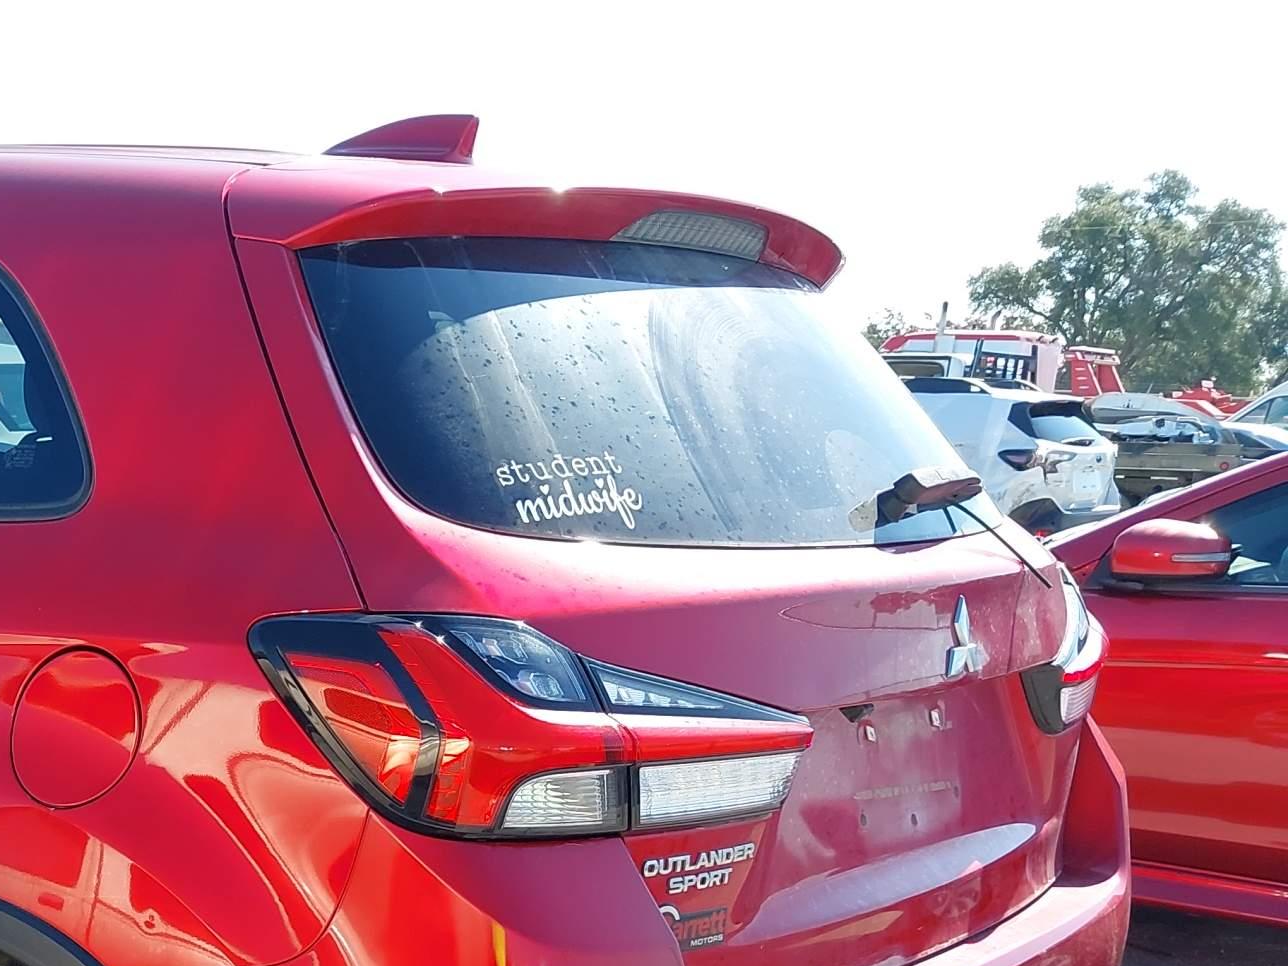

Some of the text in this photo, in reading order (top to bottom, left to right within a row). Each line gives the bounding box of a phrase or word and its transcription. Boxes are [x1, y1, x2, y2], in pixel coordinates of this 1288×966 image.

[496, 451, 622, 486] student
[516, 474, 642, 529] midwife
[643, 843, 755, 878] OUTLANDER
[669, 868, 733, 894] SPORT
[690, 934, 724, 947] MOTORS
